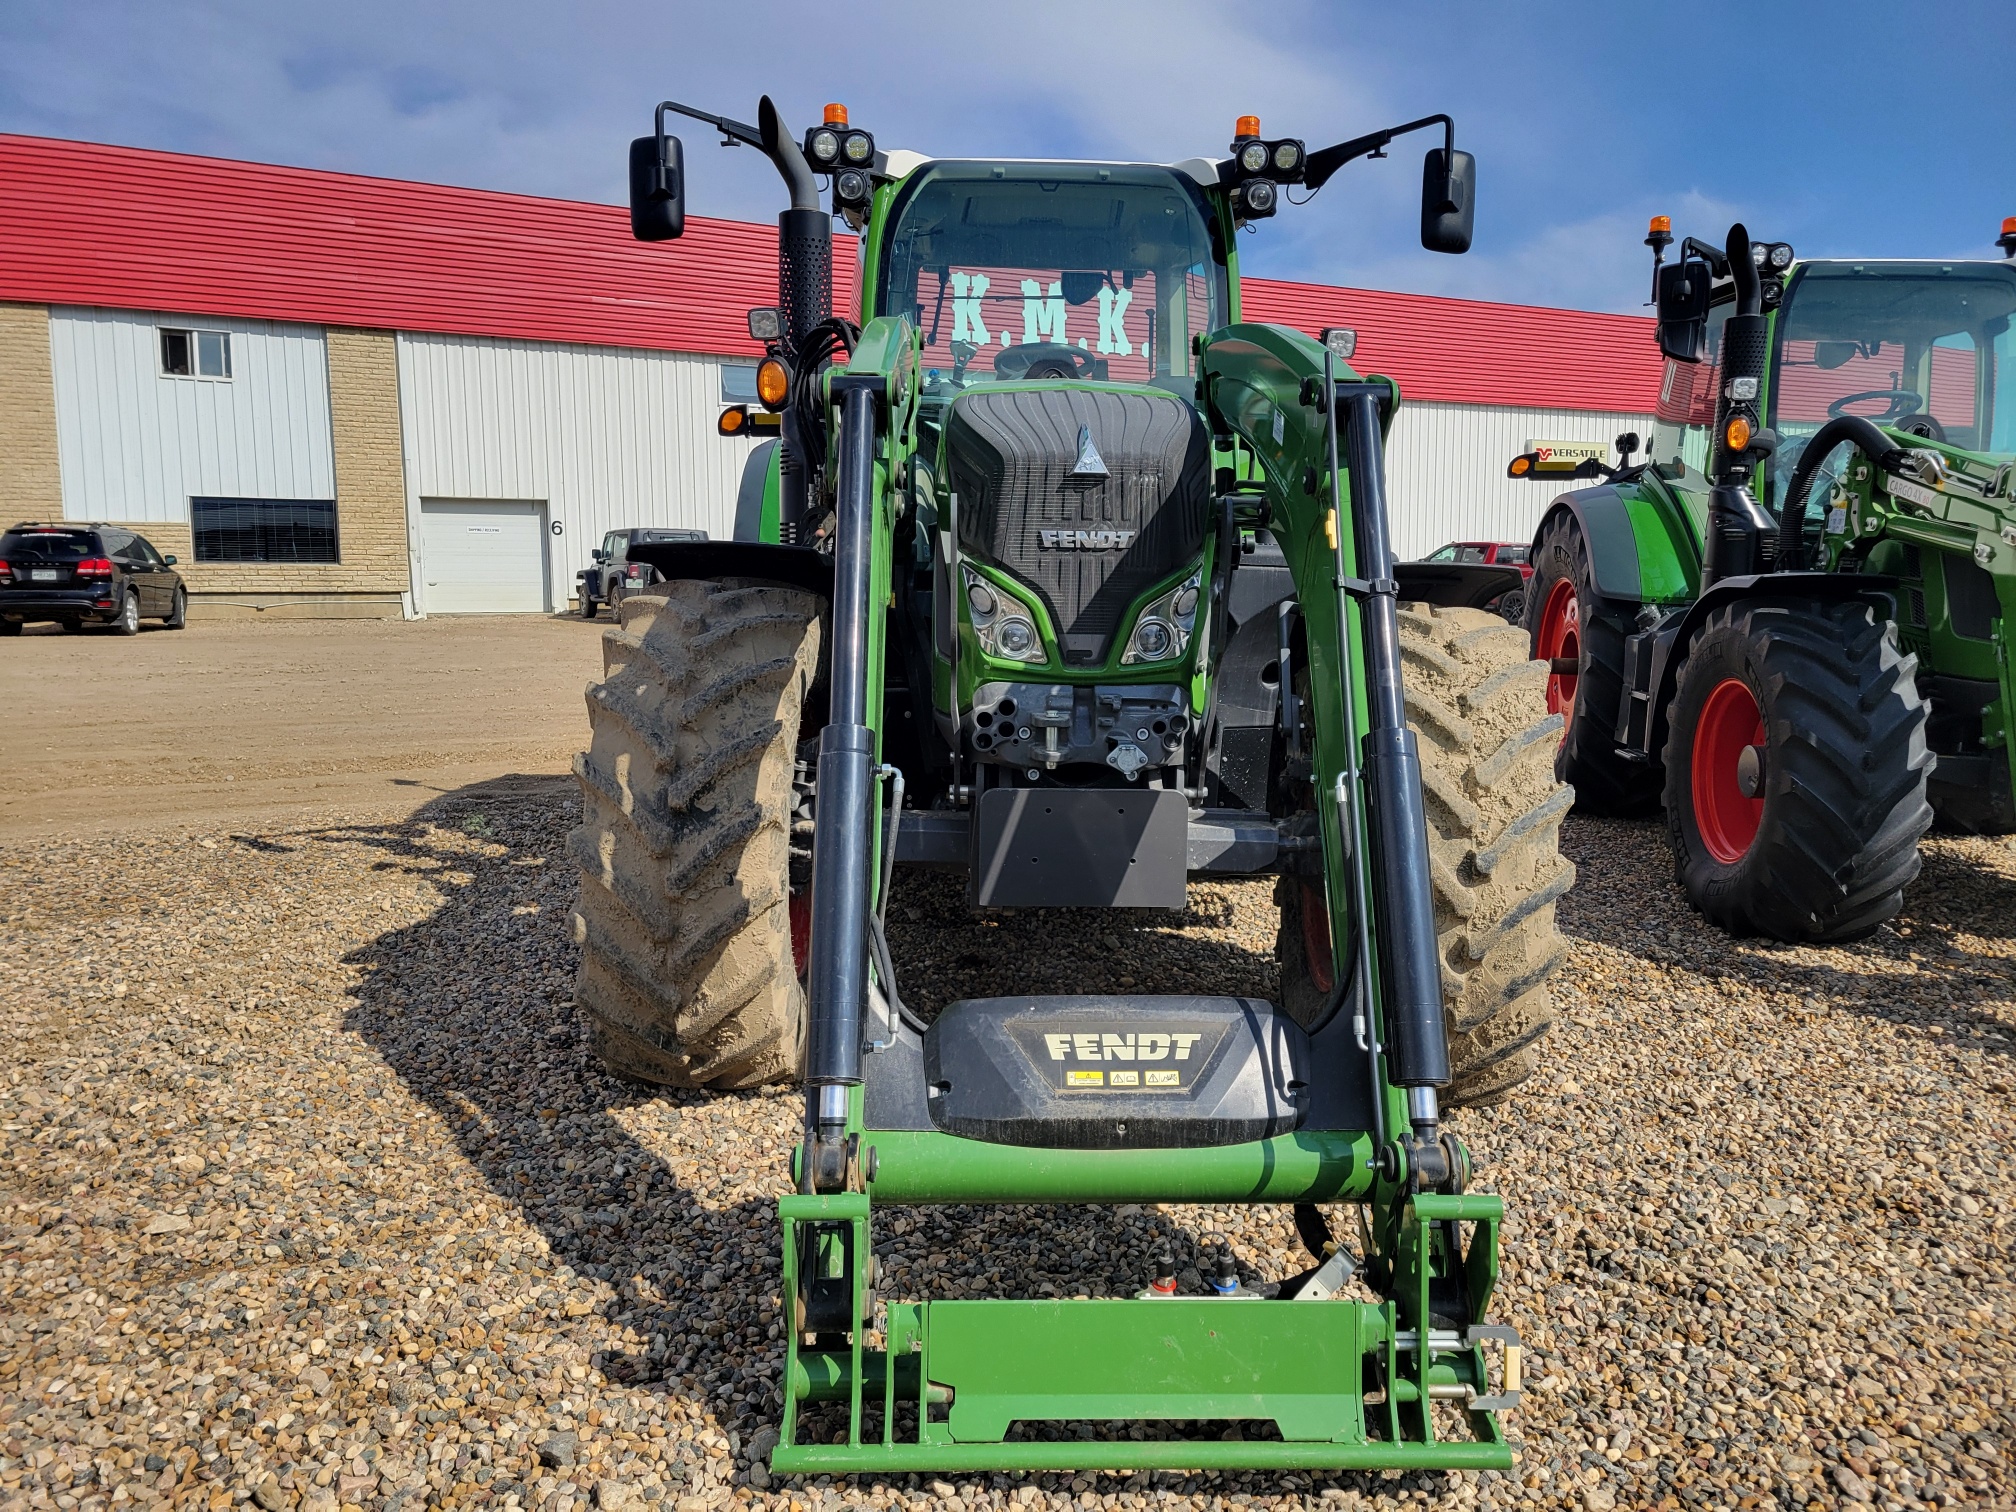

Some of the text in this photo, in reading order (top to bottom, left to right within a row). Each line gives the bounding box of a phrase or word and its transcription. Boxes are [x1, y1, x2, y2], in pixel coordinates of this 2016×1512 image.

[1553, 448, 1606, 458] VERSATILE
[1890, 480, 1912, 497] CARGO
[1913, 489, 1923, 501] 4X
[551, 520, 563, 536] 6
[1040, 530, 1135, 548] FENDT
[1044, 1033, 1201, 1060] FENDT
